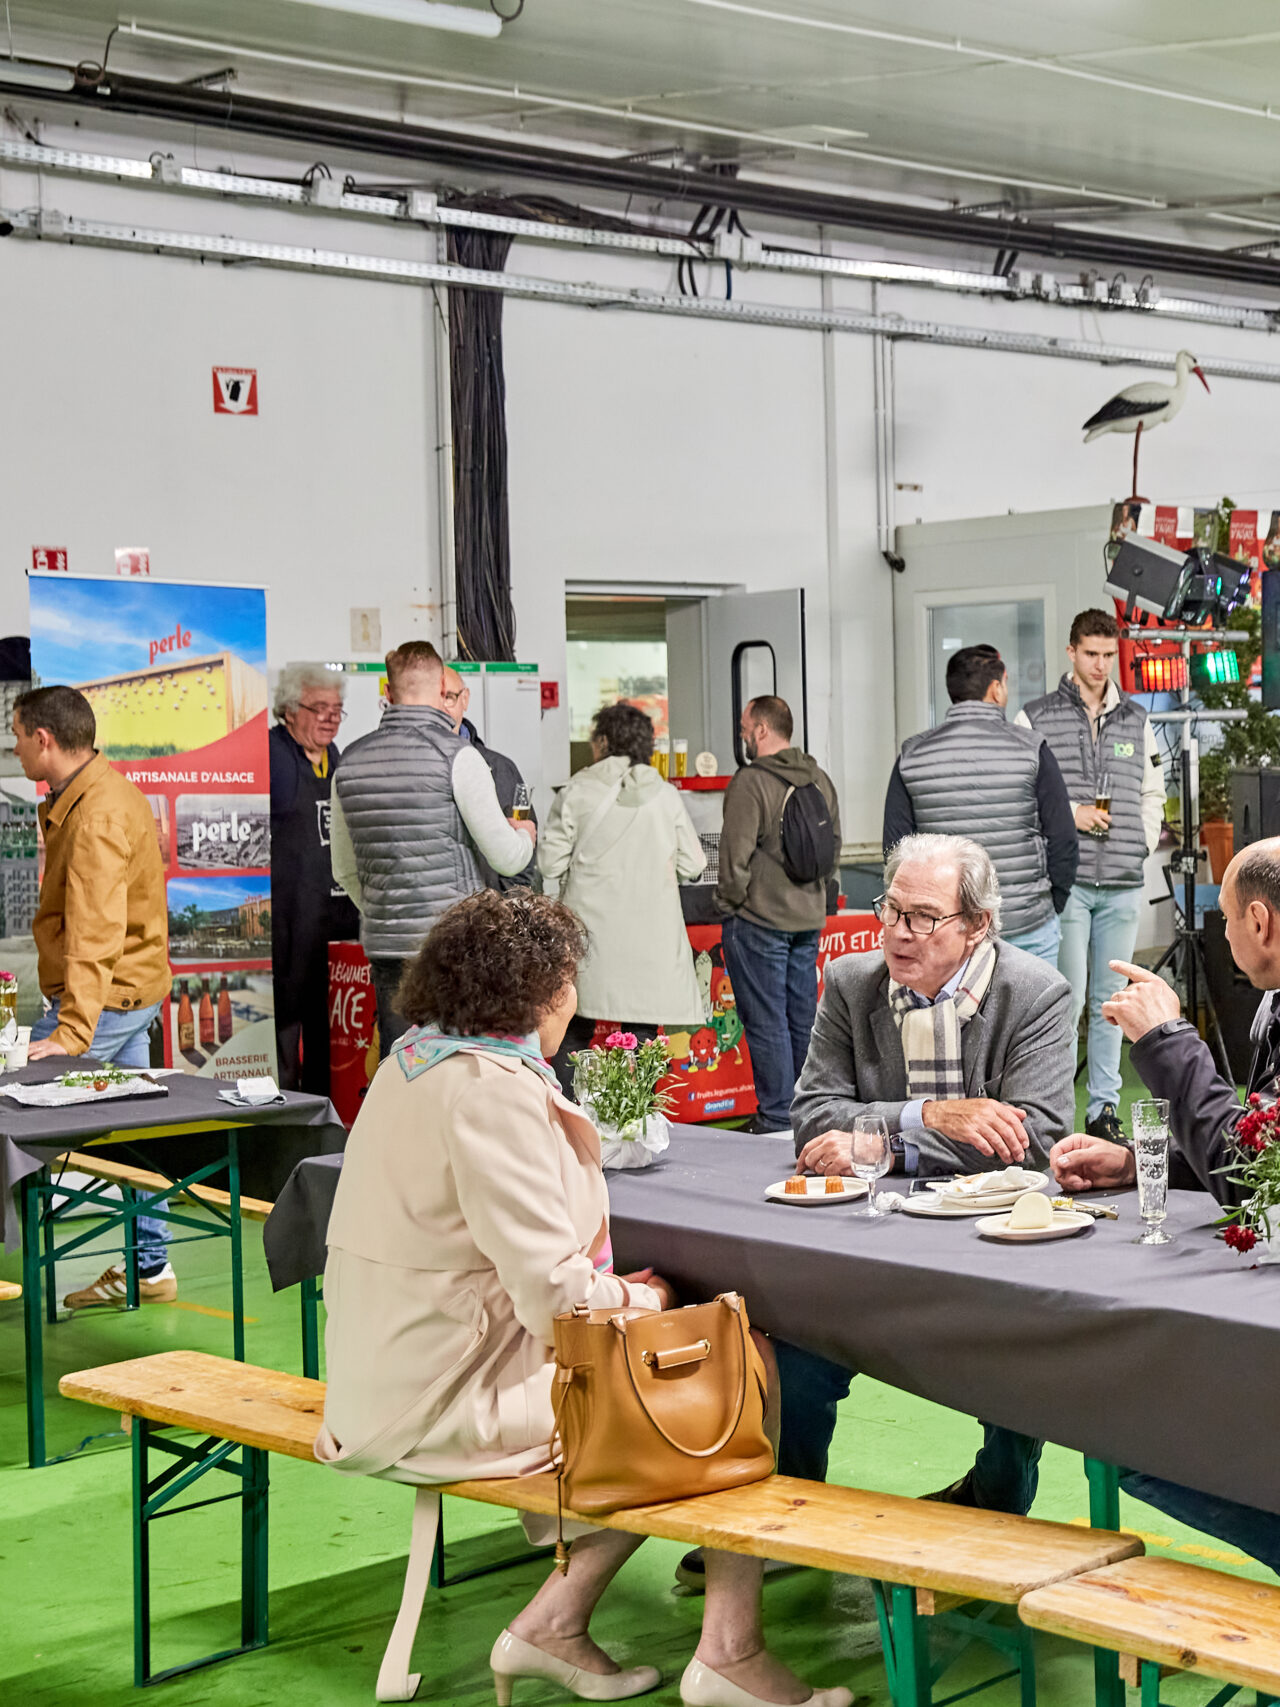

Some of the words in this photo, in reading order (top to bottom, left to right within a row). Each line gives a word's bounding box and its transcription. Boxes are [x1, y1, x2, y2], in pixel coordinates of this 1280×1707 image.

[149, 623, 192, 665] perle
[202, 771, 255, 783] D'ALSACE
[192, 811, 251, 852] perle
[819, 932, 846, 952] UITS
[850, 930, 870, 950] ET
[215, 1053, 269, 1067] BRASSERIE
